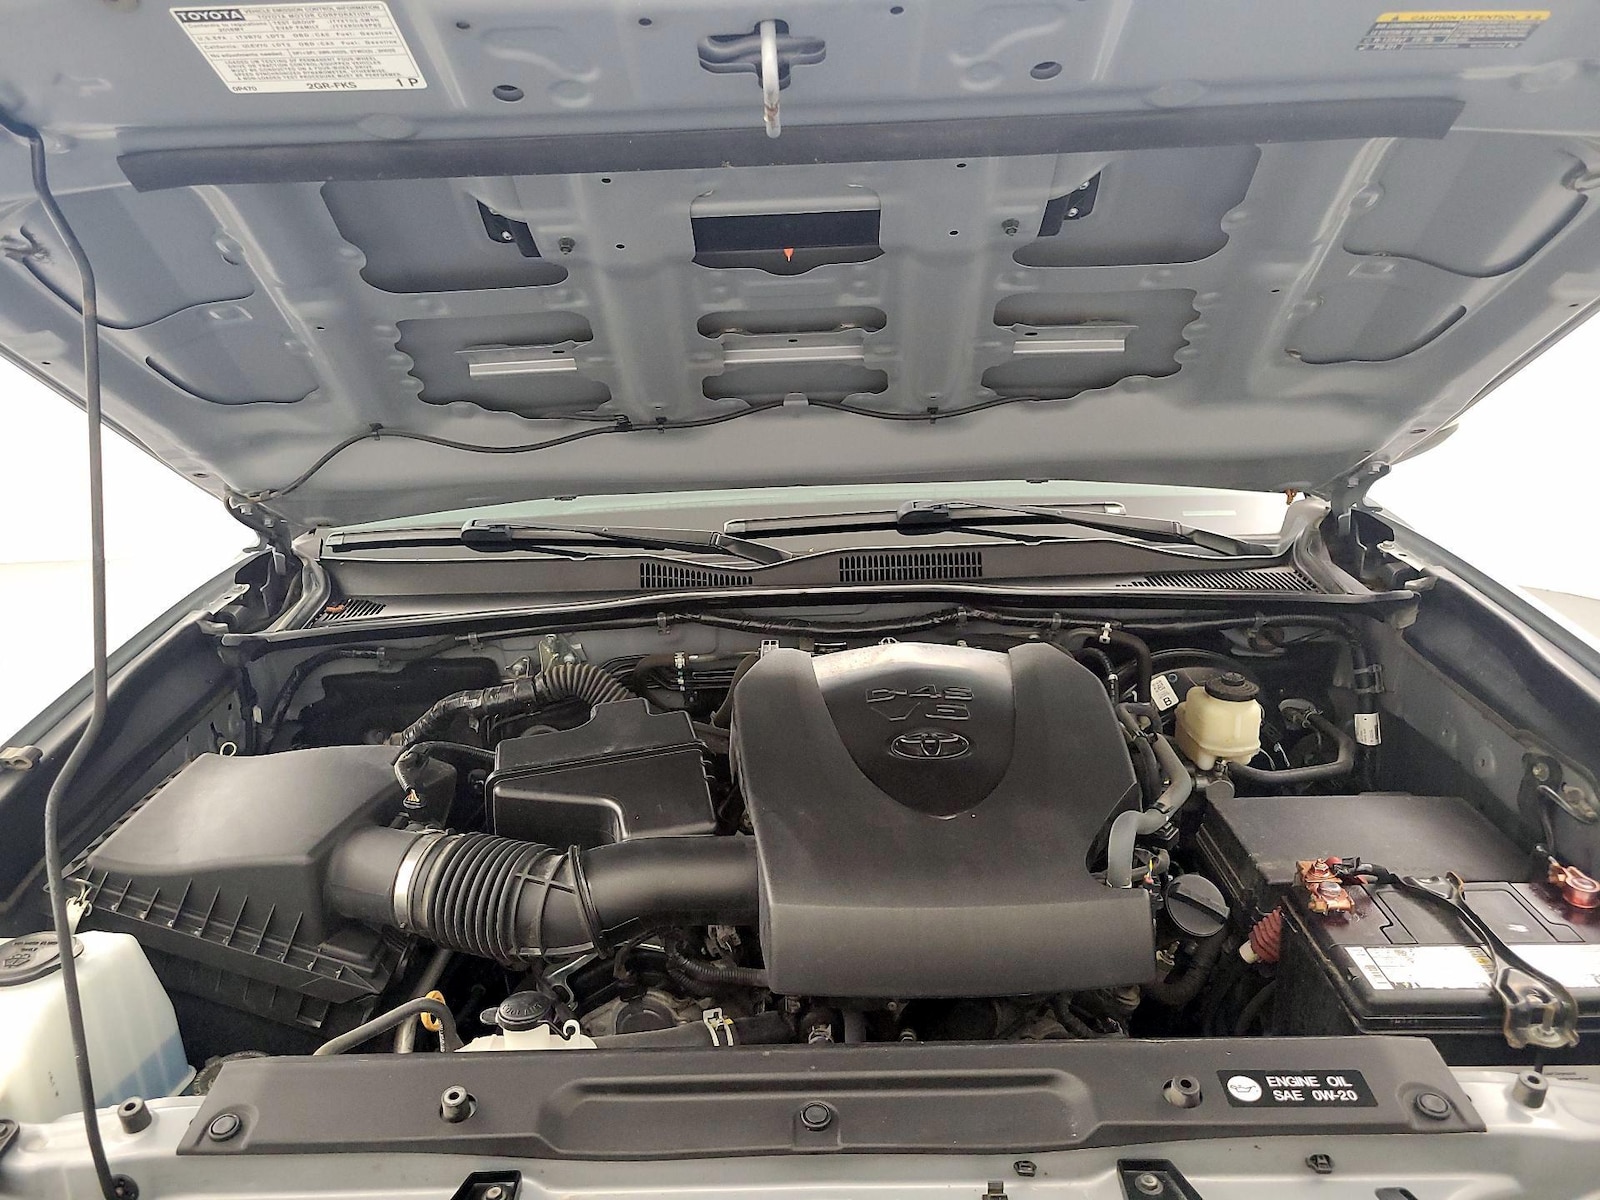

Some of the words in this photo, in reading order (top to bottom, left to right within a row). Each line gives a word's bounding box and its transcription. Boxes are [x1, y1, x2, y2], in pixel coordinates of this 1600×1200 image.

[177, 10, 242, 20] TOYOTA
[305, 81, 357, 89] 2GR-FKS
[395, 78, 403, 87] 1
[408, 78, 420, 86] P
[1265, 1076, 1320, 1087] ENGINE
[1326, 1076, 1353, 1087] OIL
[1273, 1089, 1305, 1101] SAE
[1311, 1090, 1358, 1101] 0W-20
